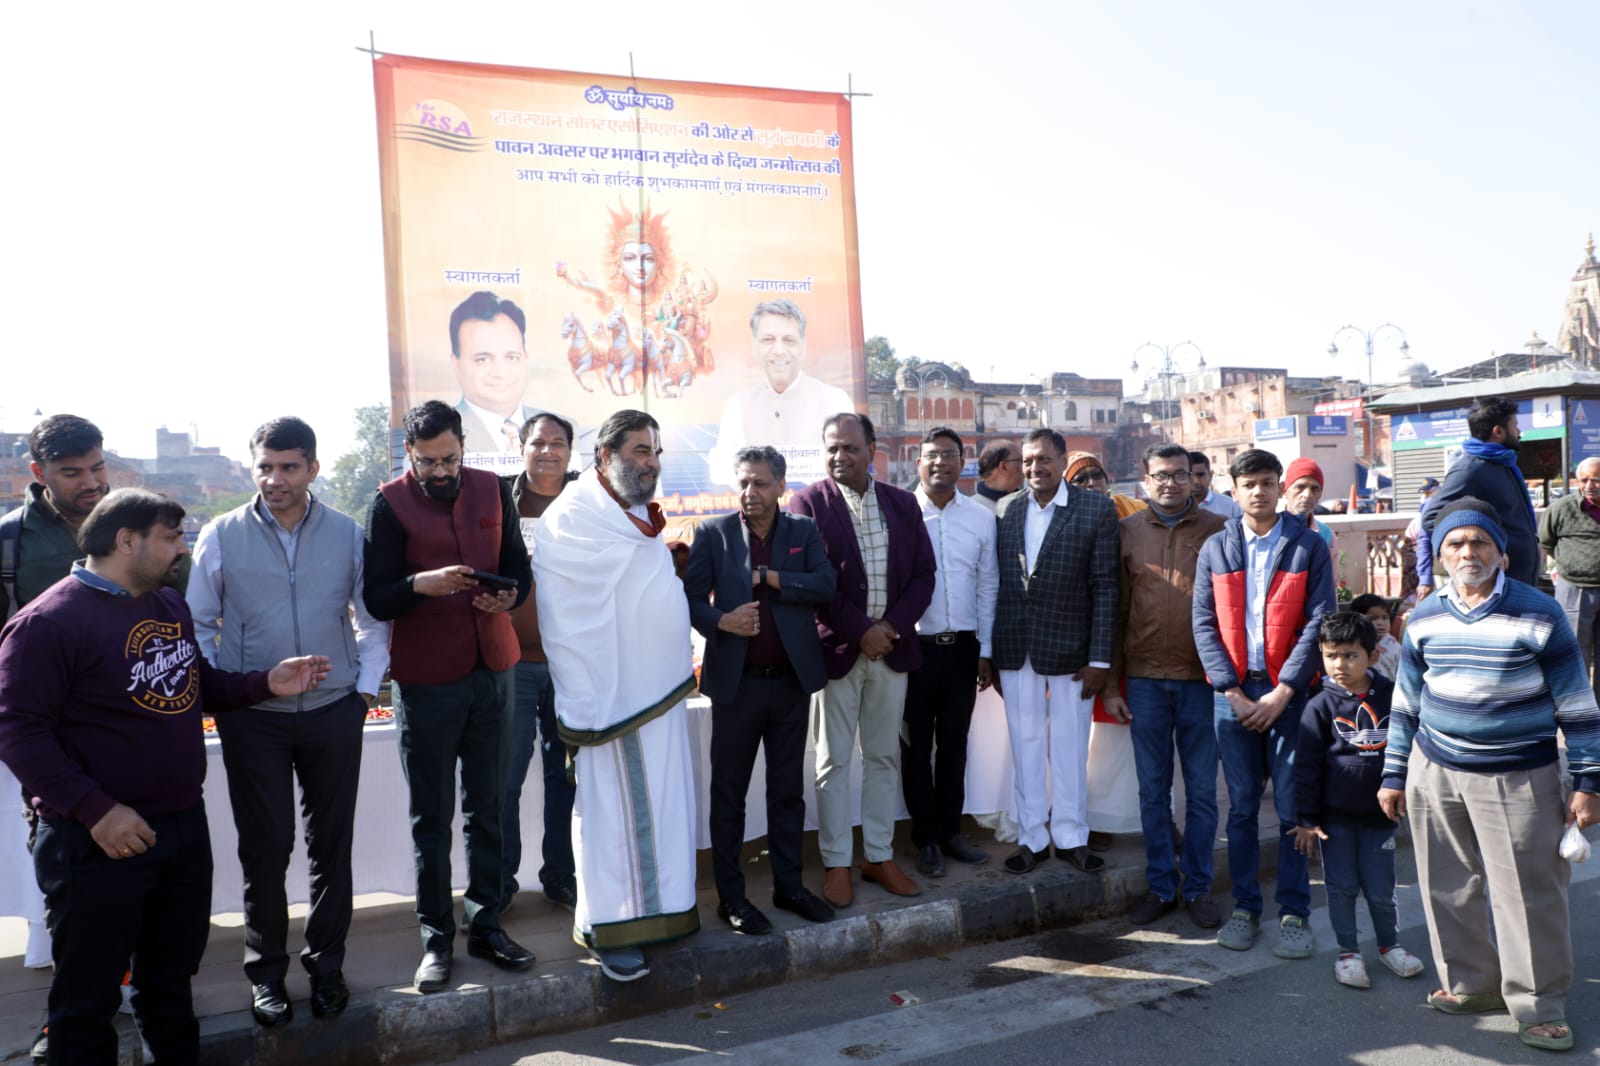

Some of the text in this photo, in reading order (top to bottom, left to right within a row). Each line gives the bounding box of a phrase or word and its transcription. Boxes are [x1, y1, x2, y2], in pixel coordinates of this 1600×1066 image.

[646, 94, 673, 109] नमः
[420, 111, 473, 137] RSA
[494, 111, 562, 128] राजस्थान
[566, 112, 605, 131] सोलर
[691, 122, 710, 139] की
[712, 124, 740, 140] ओर
[741, 126, 754, 141] से
[827, 132, 840, 148] के
[495, 140, 841, 175] पावन अवसर पर भगवान सूर्यदेव के दिव्य जन्मोत्सव की
[516, 169, 544, 182] आप
[548, 167, 577, 184] सभी
[581, 169, 600, 185] को
[604, 171, 644, 187] हार्दिक
[724, 178, 742, 196] एवं
[445, 267, 521, 286] स्वागतकर्ता
[748, 276, 813, 293] स्वागतकर्ता
